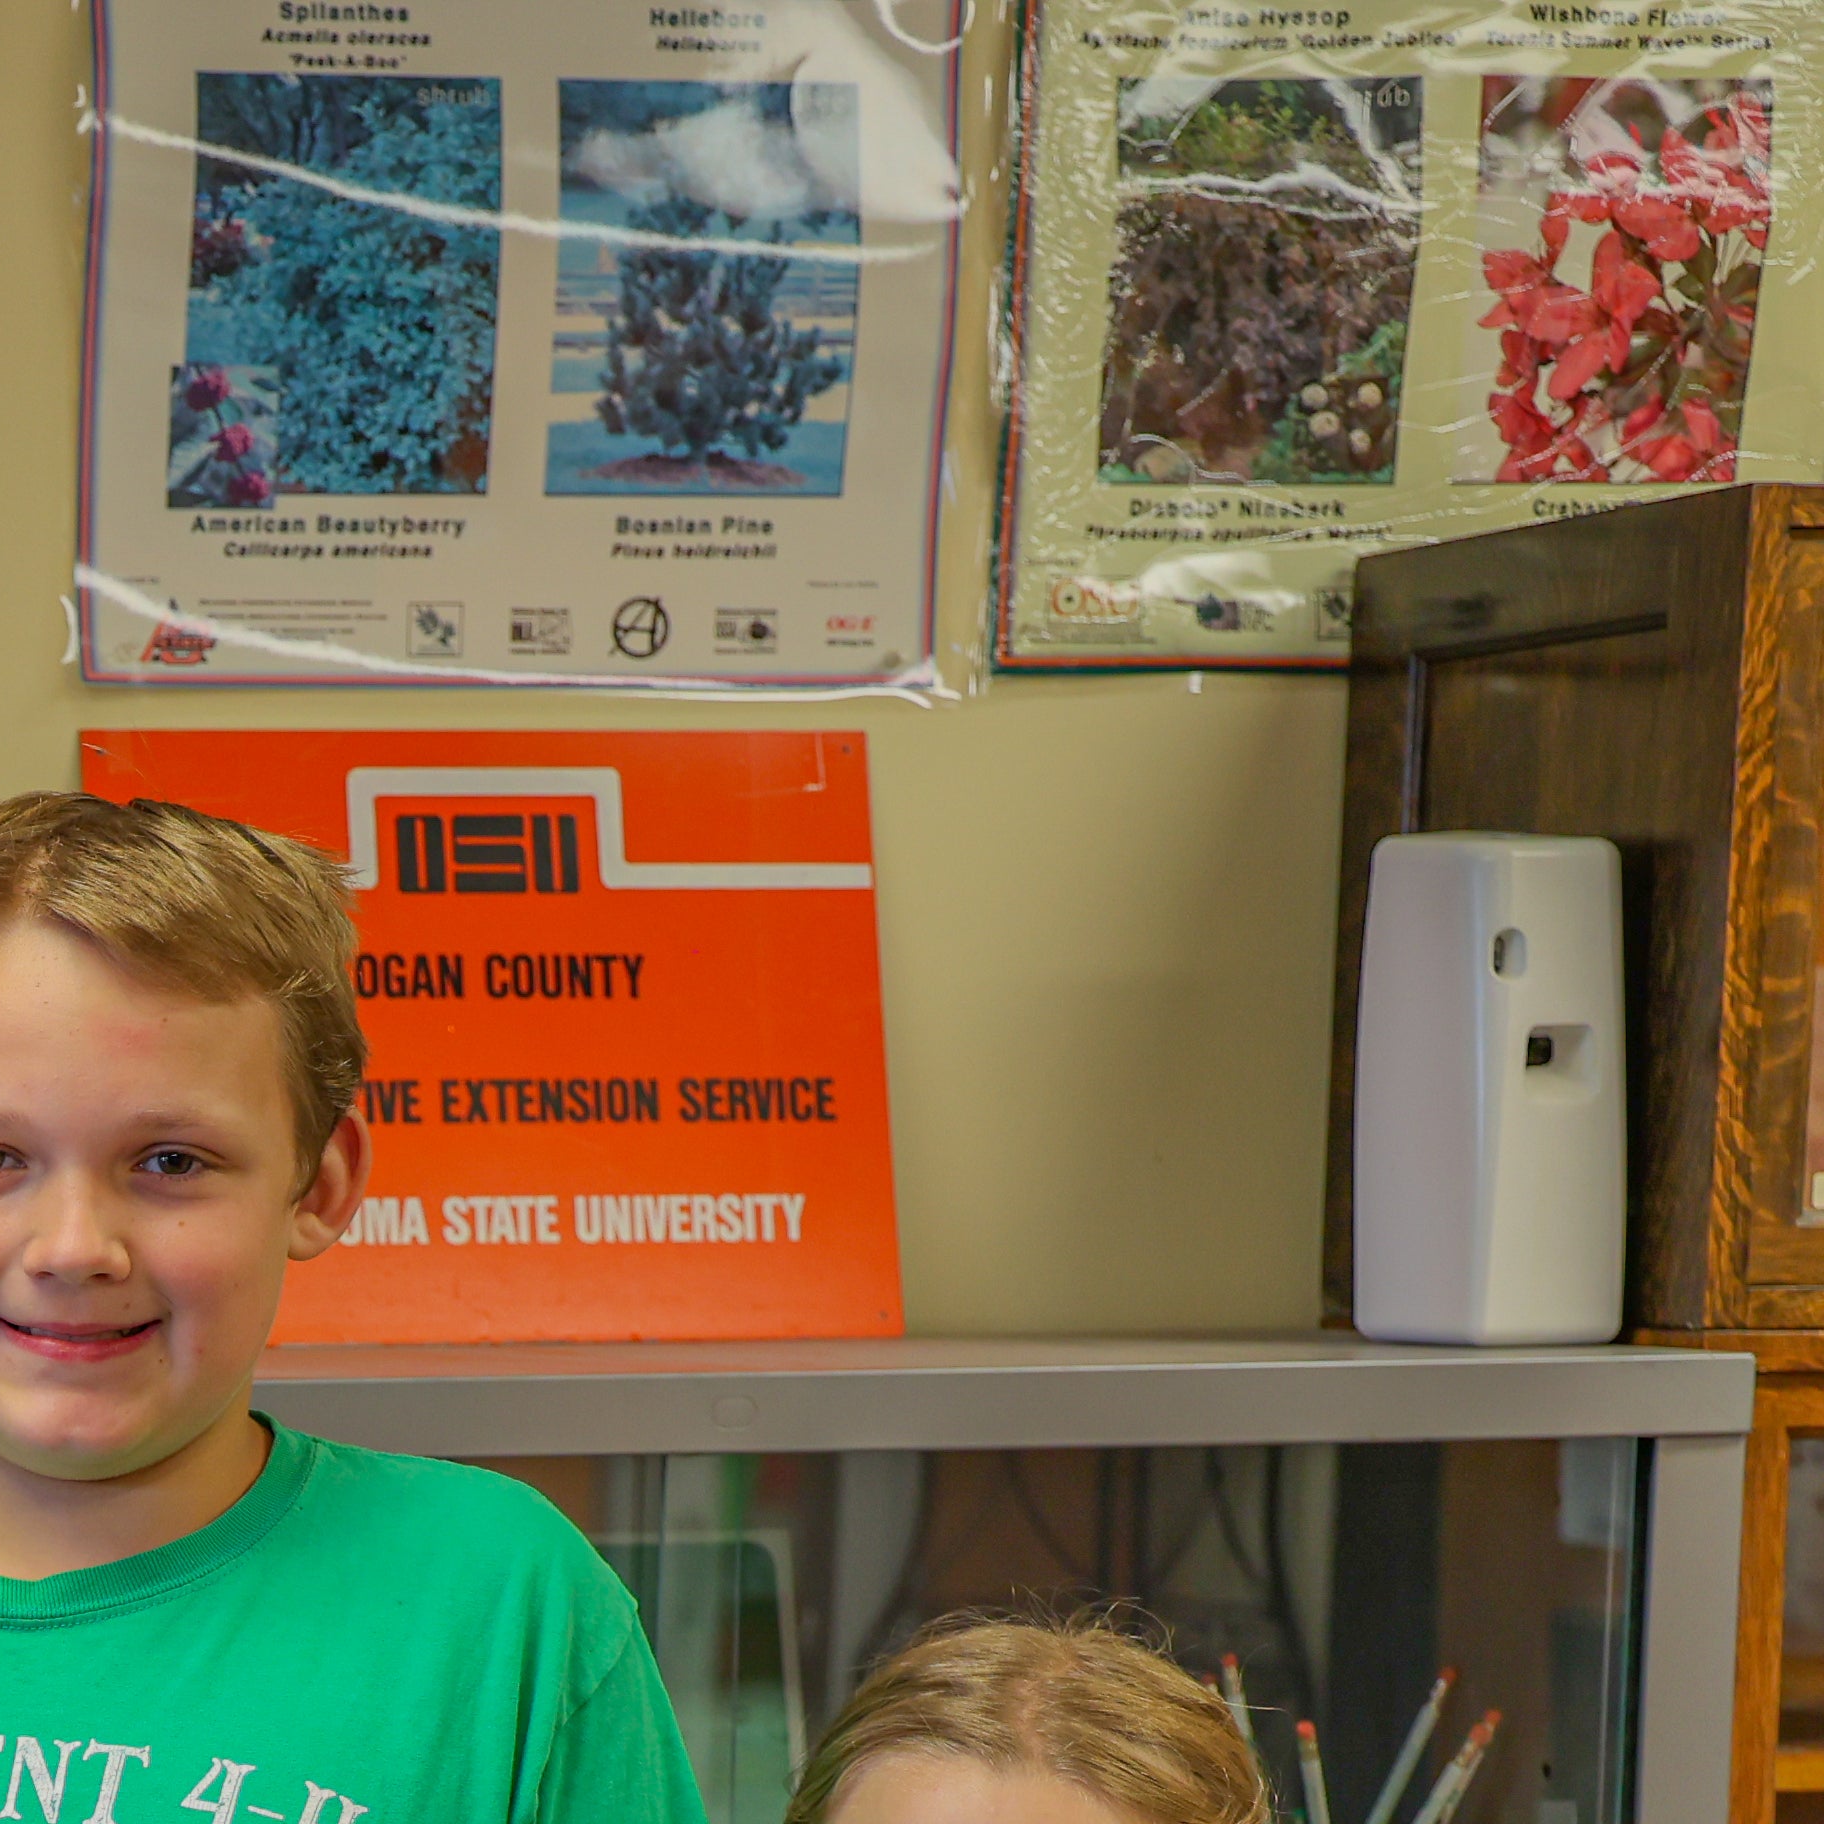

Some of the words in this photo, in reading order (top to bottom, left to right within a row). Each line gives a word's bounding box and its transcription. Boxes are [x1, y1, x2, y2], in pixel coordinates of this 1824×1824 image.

[279, 1, 410, 23] Spilanthes
[649, 8, 767, 28] Hellebore
[1260, 7, 1352, 30] Hyssop
[1529, 4, 1640, 25] Wishbone
[190, 515, 307, 534] American
[317, 514, 467, 539] Beautyberry
[615, 515, 712, 535] Bosnian
[721, 515, 775, 535] Pine
[395, 813, 580, 894] OSU
[355, 953, 465, 999] OGAN
[484, 953, 645, 999] COUNTY
[440, 1078, 661, 1124] EXTENSION
[678, 1077, 837, 1124] SERVICE
[441, 1194, 561, 1247] STATE
[574, 1193, 806, 1245] UNIVERSITY
